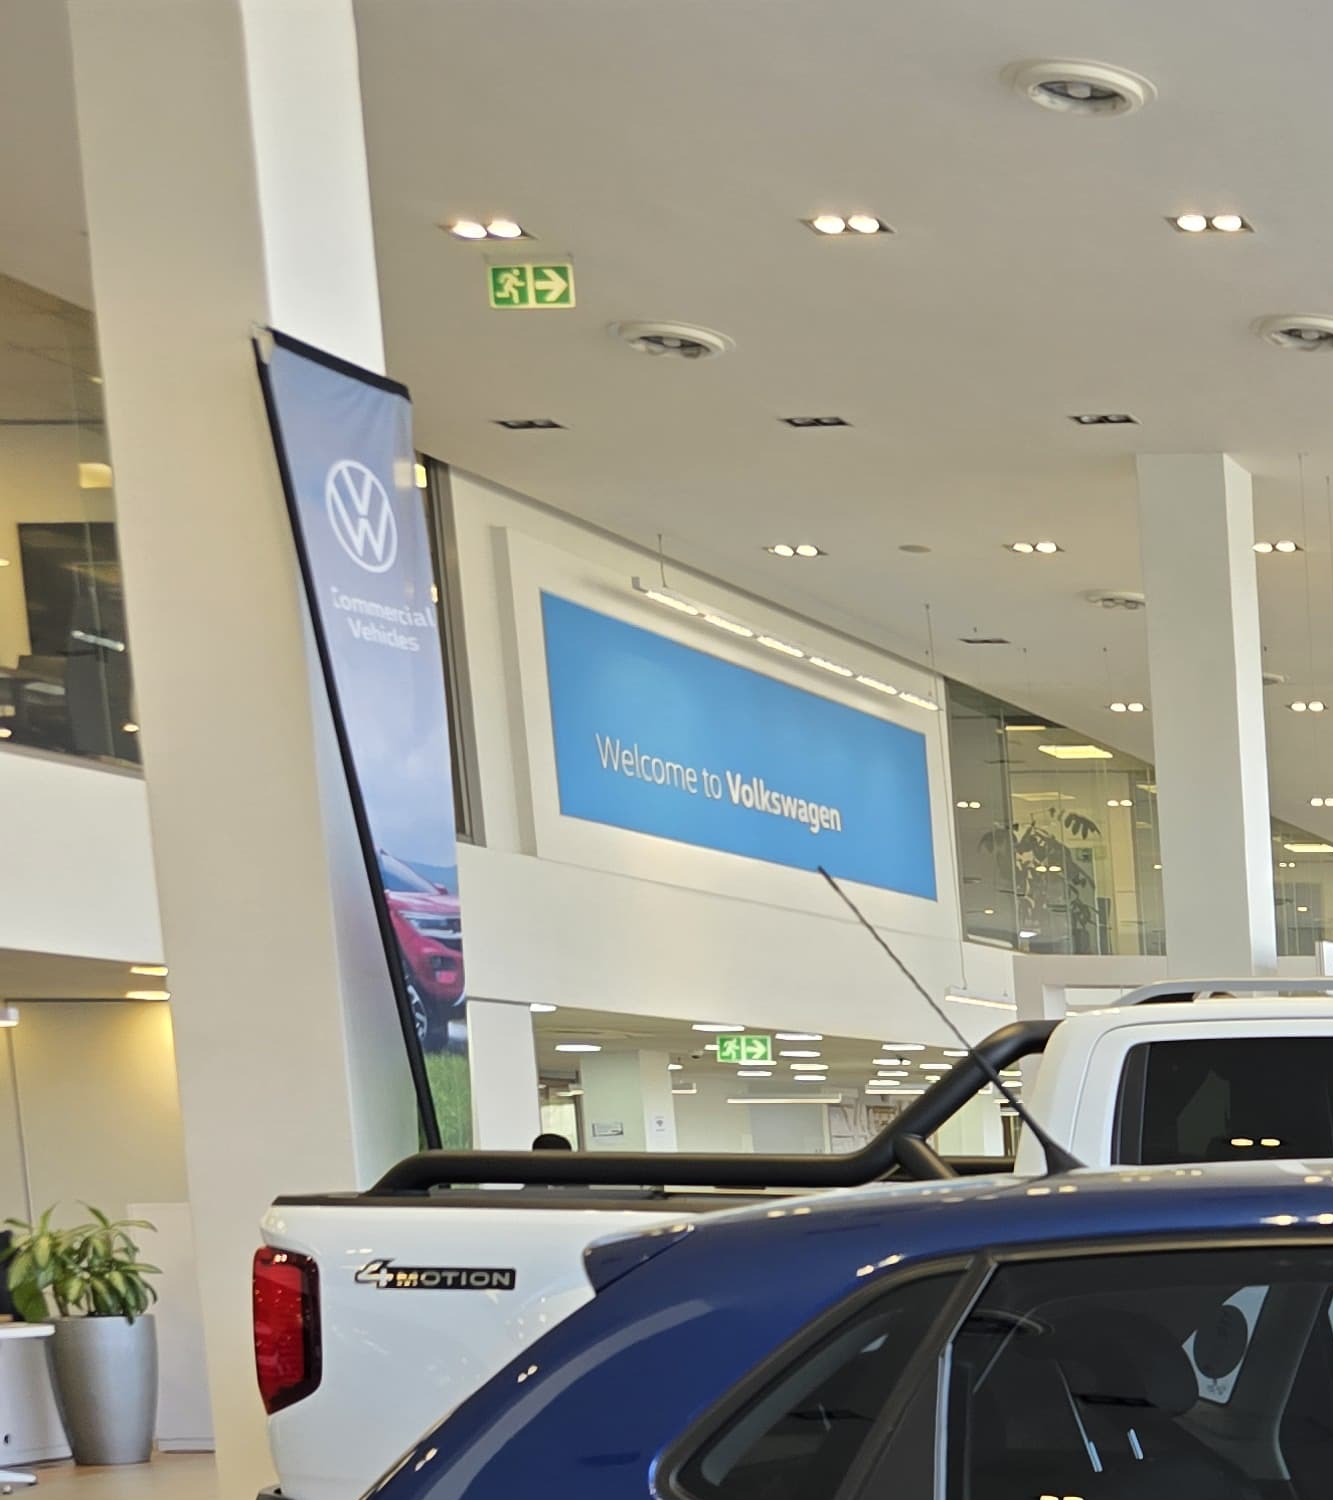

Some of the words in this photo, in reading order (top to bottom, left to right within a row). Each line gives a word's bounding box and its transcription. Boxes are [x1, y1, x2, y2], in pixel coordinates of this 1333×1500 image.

[325, 459, 398, 573] VW
[348, 616, 420, 651] Vehicles
[595, 732, 698, 794] Welcome
[702, 767, 722, 800] to
[726, 769, 842, 834] Volkswagen
[355, 1259, 512, 1289] 4MOTION
